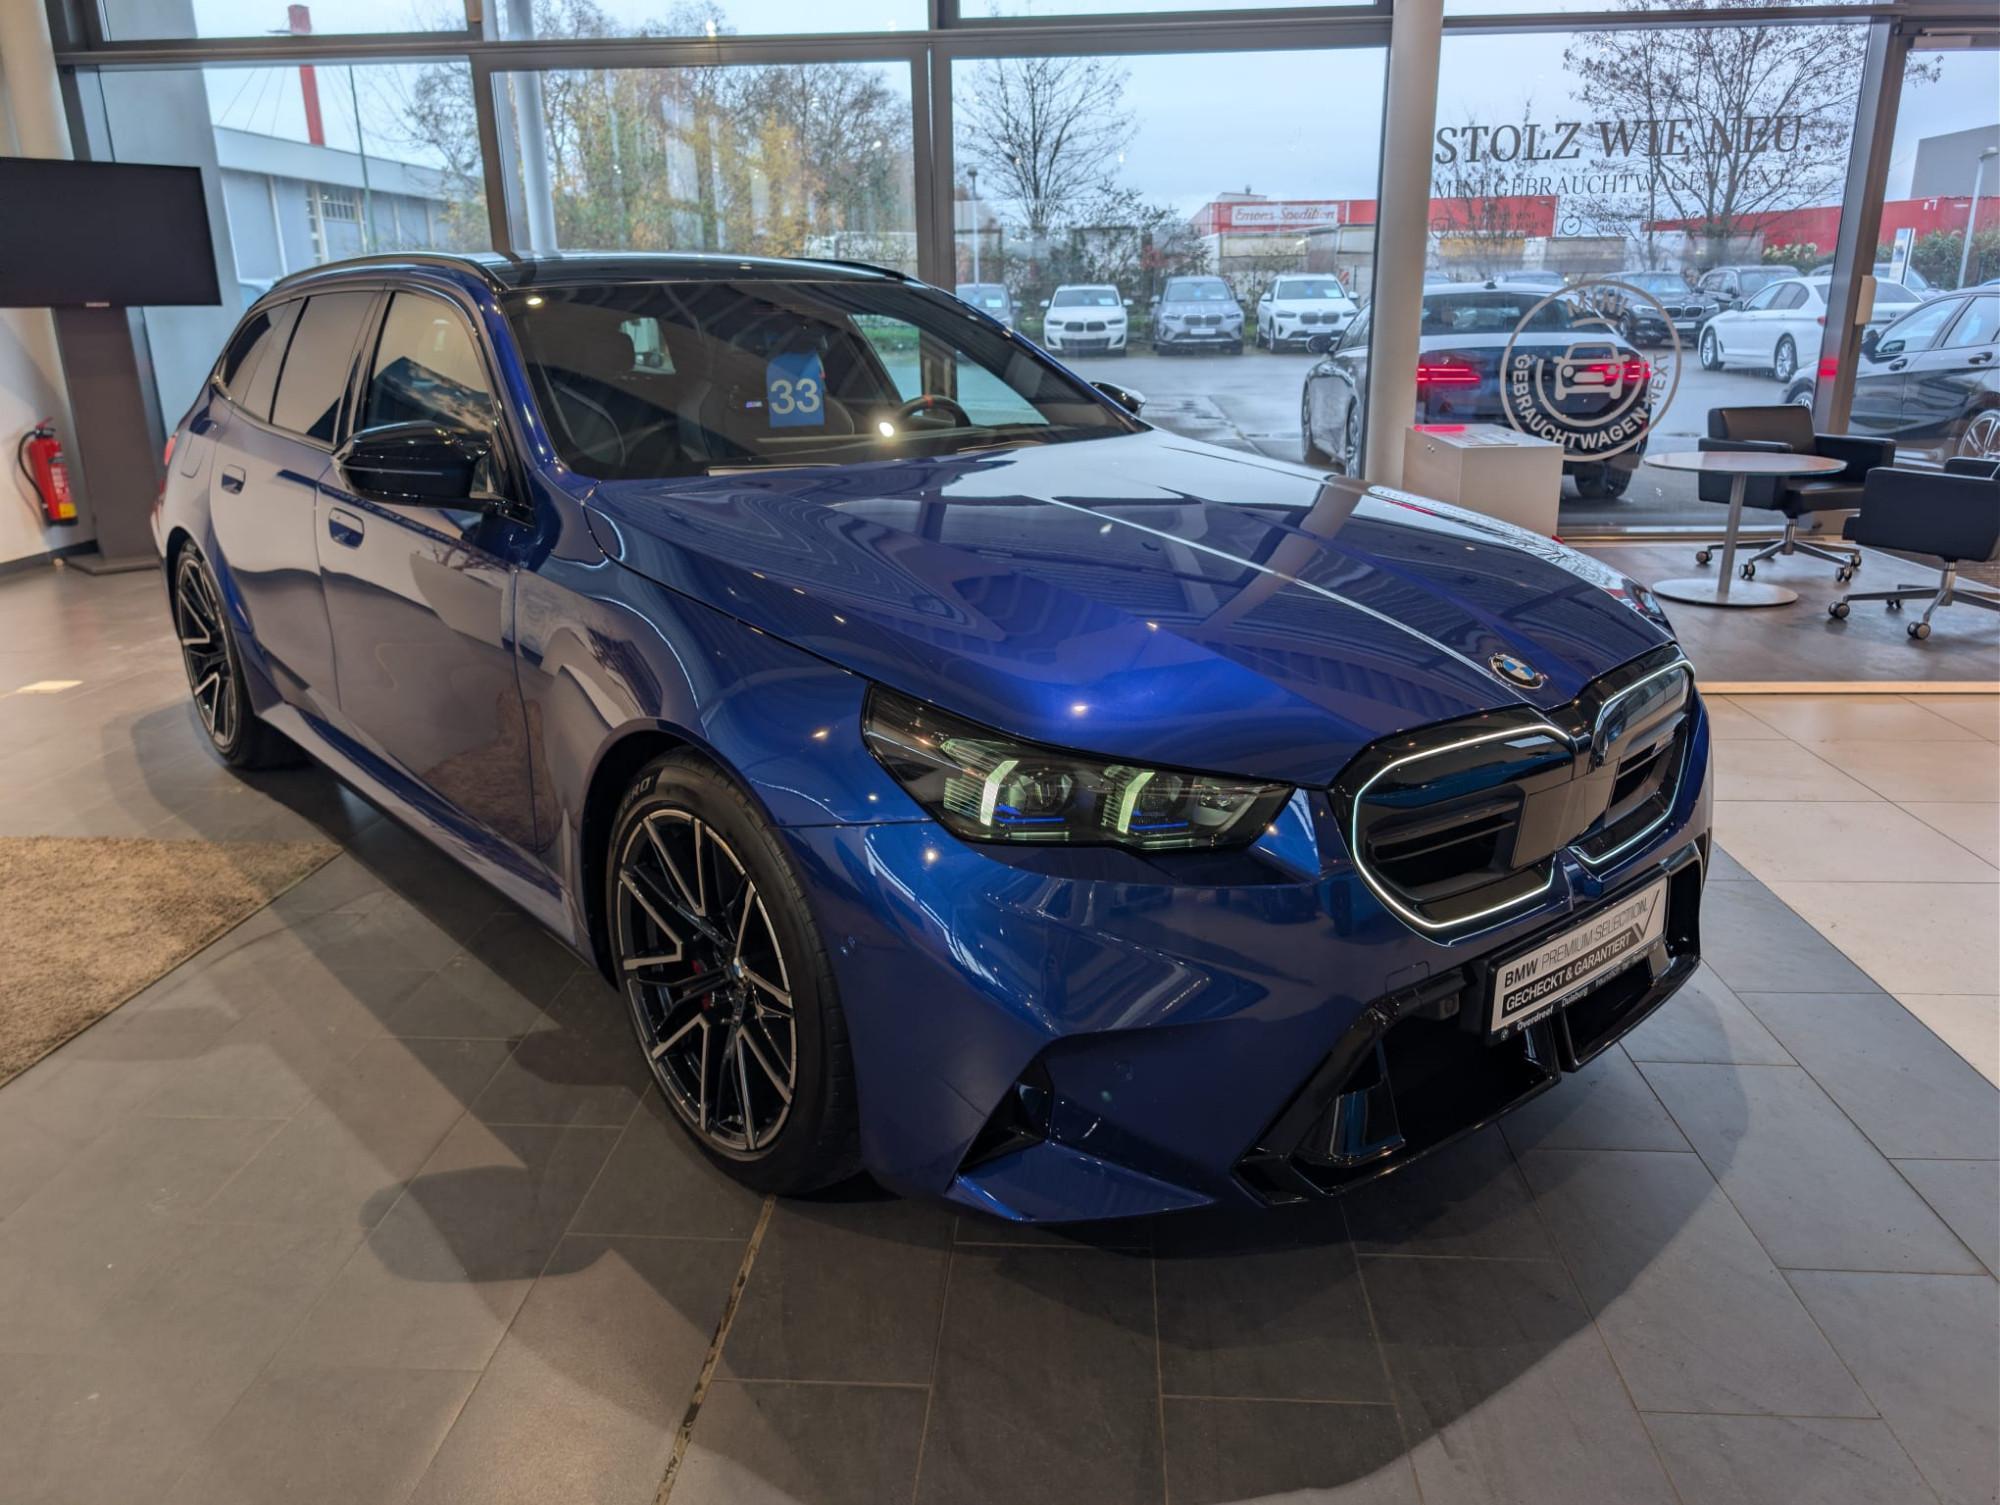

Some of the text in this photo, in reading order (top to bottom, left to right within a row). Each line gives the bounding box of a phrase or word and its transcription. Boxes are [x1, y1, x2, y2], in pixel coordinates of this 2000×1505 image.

[1434, 115, 1812, 164] STOLZ WIE NEU.
[1567, 287, 1629, 316] MINI
[770, 378, 820, 414] 33
[1513, 355, 1649, 449] GEBRAUCHTWAGEN
[1644, 353, 1670, 407] NEXT
[1504, 958, 1538, 988] BMW
[1541, 930, 1593, 970] PREMIUM
[1506, 973, 1565, 1011] GECHECKT
[1565, 967, 1573, 982] &
[1574, 931, 1632, 976] GARANTIERT
